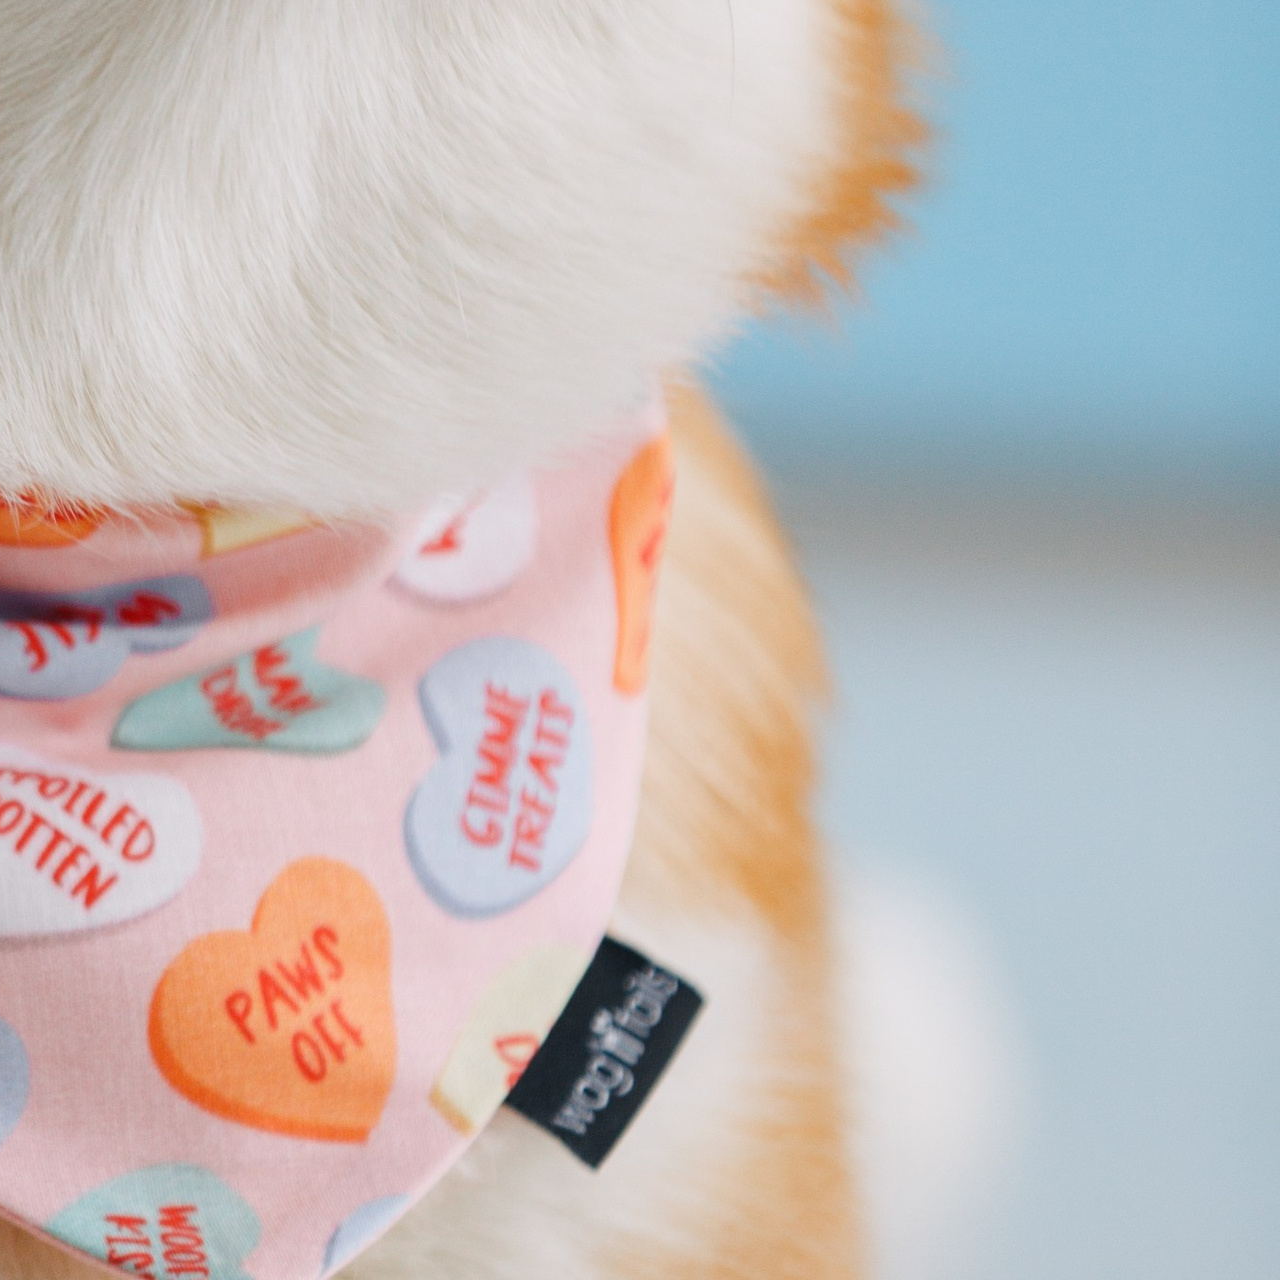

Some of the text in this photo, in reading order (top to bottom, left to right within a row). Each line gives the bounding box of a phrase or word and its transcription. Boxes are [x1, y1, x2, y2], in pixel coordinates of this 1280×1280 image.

[460, 682, 531, 849] GIMME
[508, 688, 575, 873] TREATS
[225, 924, 344, 1045] PAWS
[291, 989, 365, 1085] OFF
